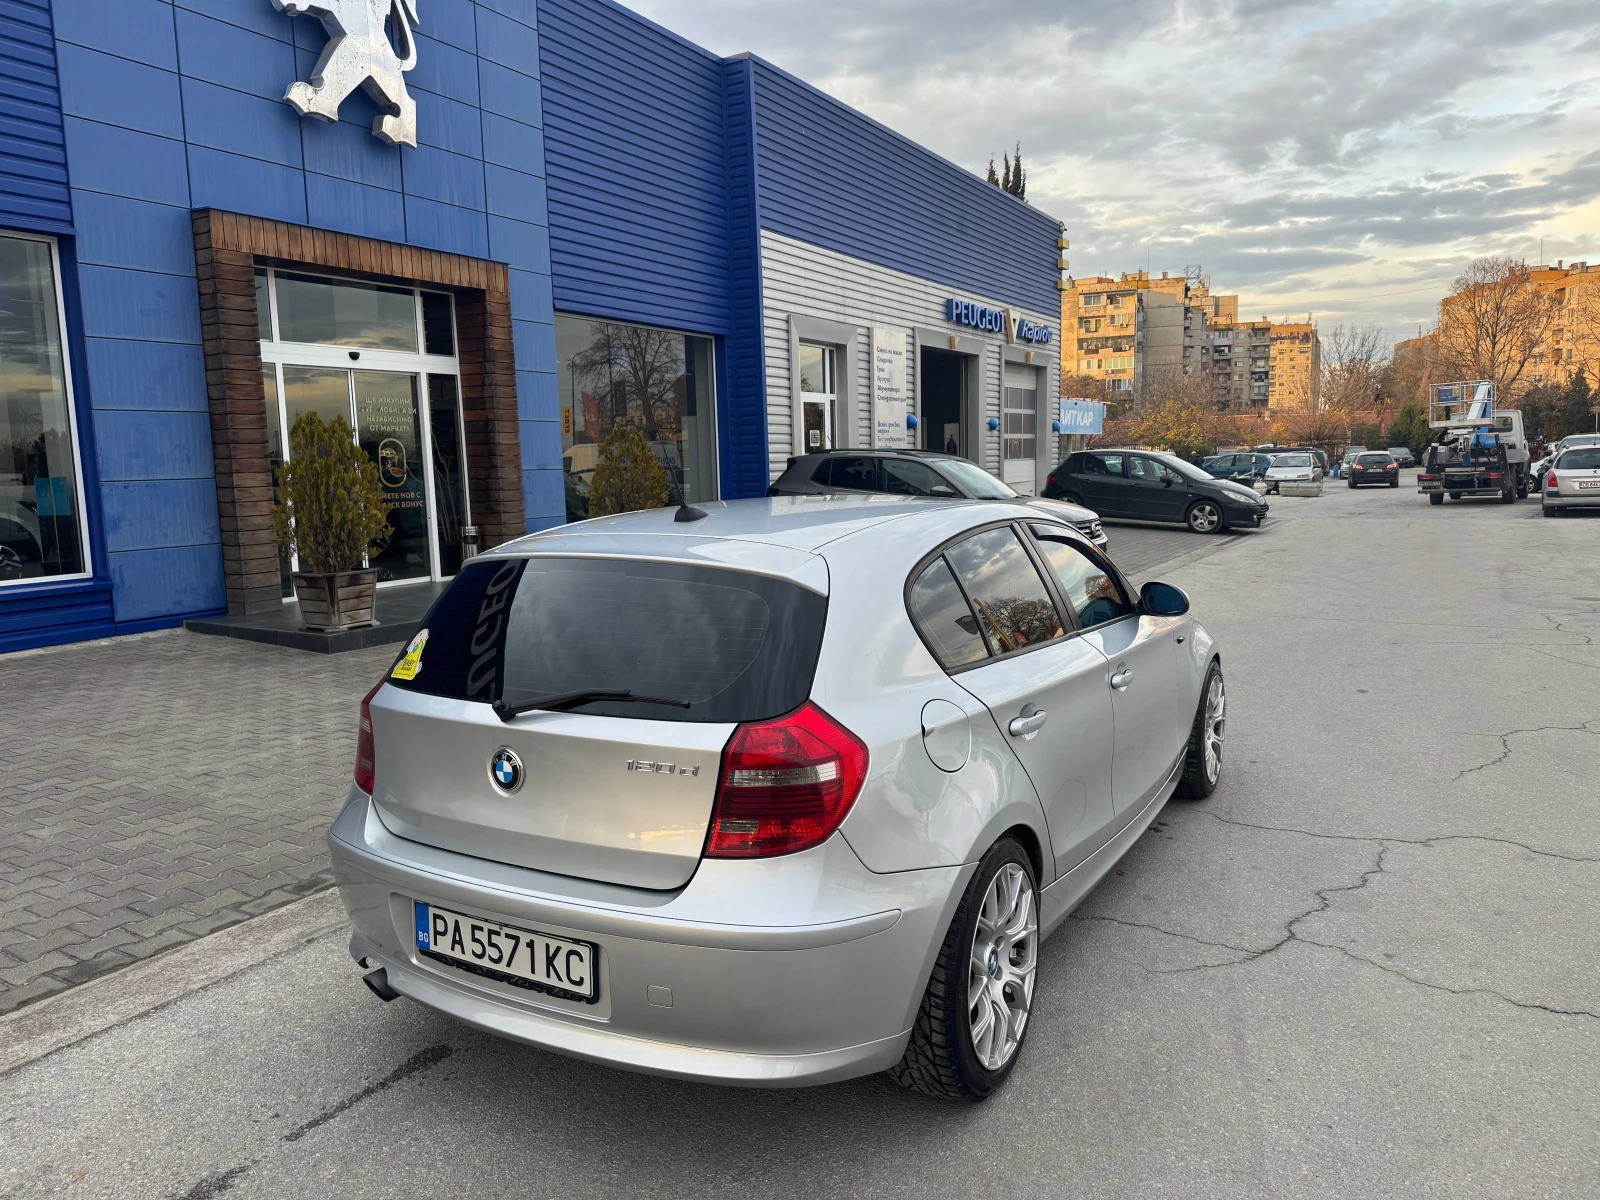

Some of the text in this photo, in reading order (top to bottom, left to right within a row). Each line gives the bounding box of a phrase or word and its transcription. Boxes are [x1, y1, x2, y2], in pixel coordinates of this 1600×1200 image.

[952, 298, 1006, 333] PEUGEOT
[365, 396, 377, 404] ЩЕ
[366, 415, 413, 423] НЕЗАВИСИМО
[369, 424, 379, 432] ОТ
[401, 500, 424, 508] БОНУС
[418, 930, 429, 943] BG
